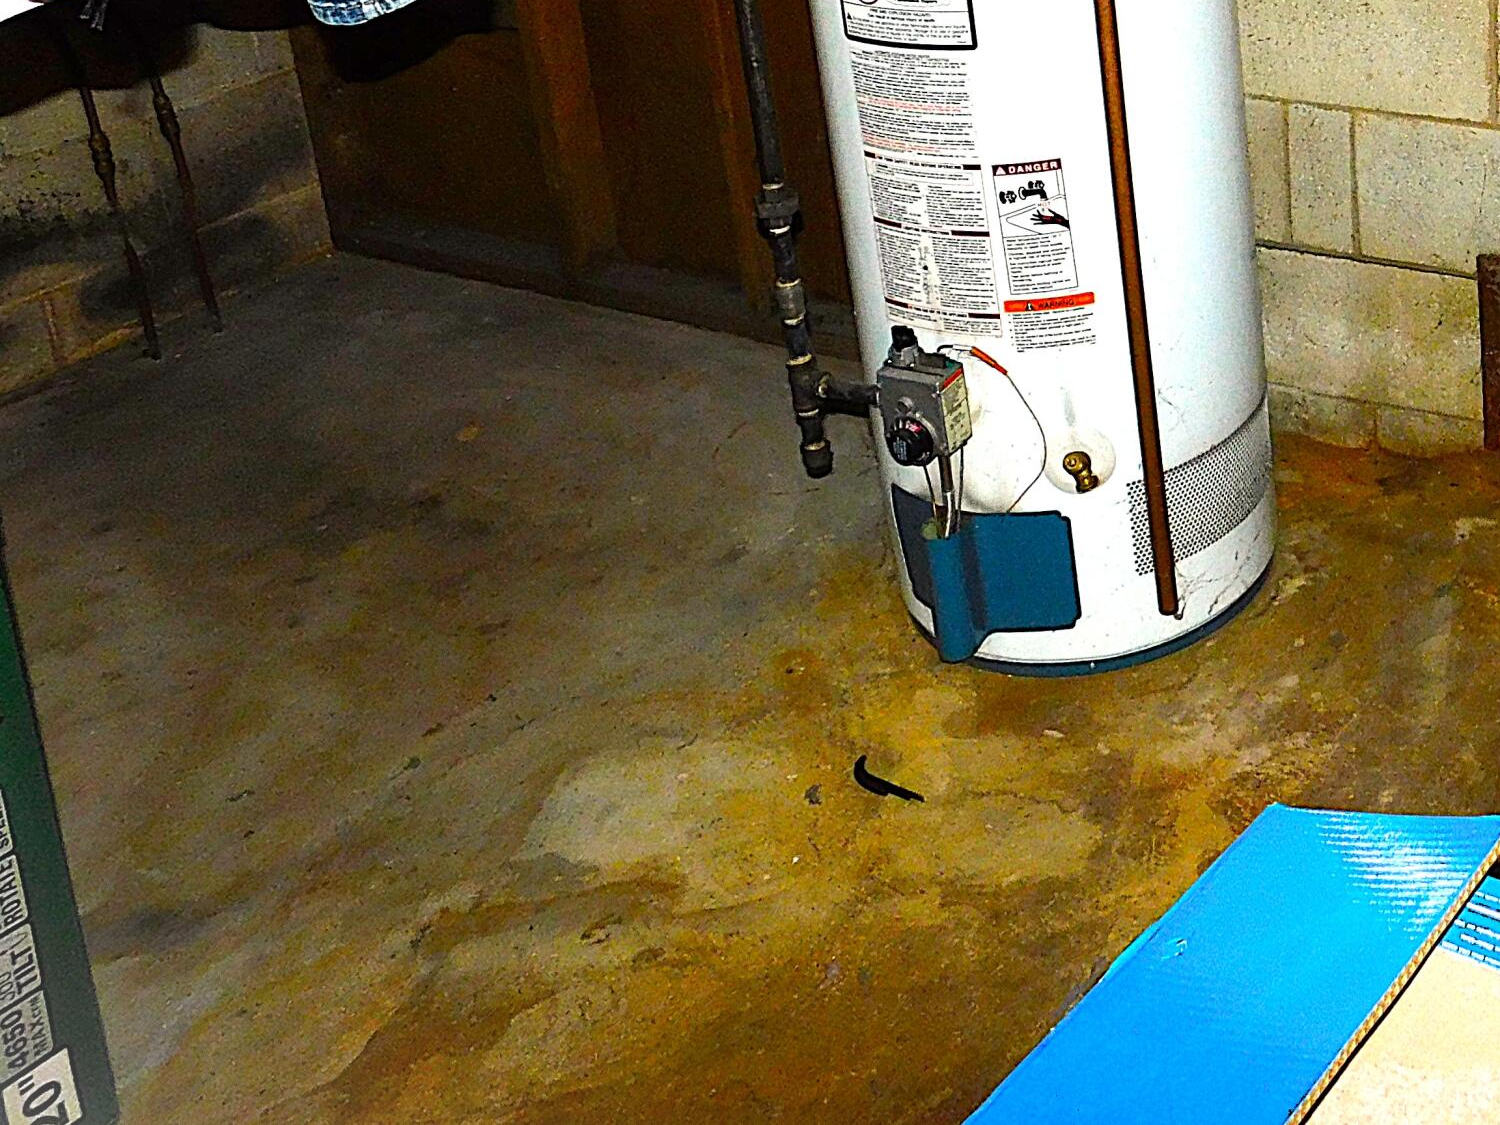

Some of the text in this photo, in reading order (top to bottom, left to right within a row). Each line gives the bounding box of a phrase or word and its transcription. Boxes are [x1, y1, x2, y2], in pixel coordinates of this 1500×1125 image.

[1008, 160, 1059, 175] DANGER
[1037, 298, 1075, 310] WARNING
[10, 946, 39, 995] TILT
[1, 1008, 30, 1069] 4650
[31, 1022, 49, 1057] MAX
